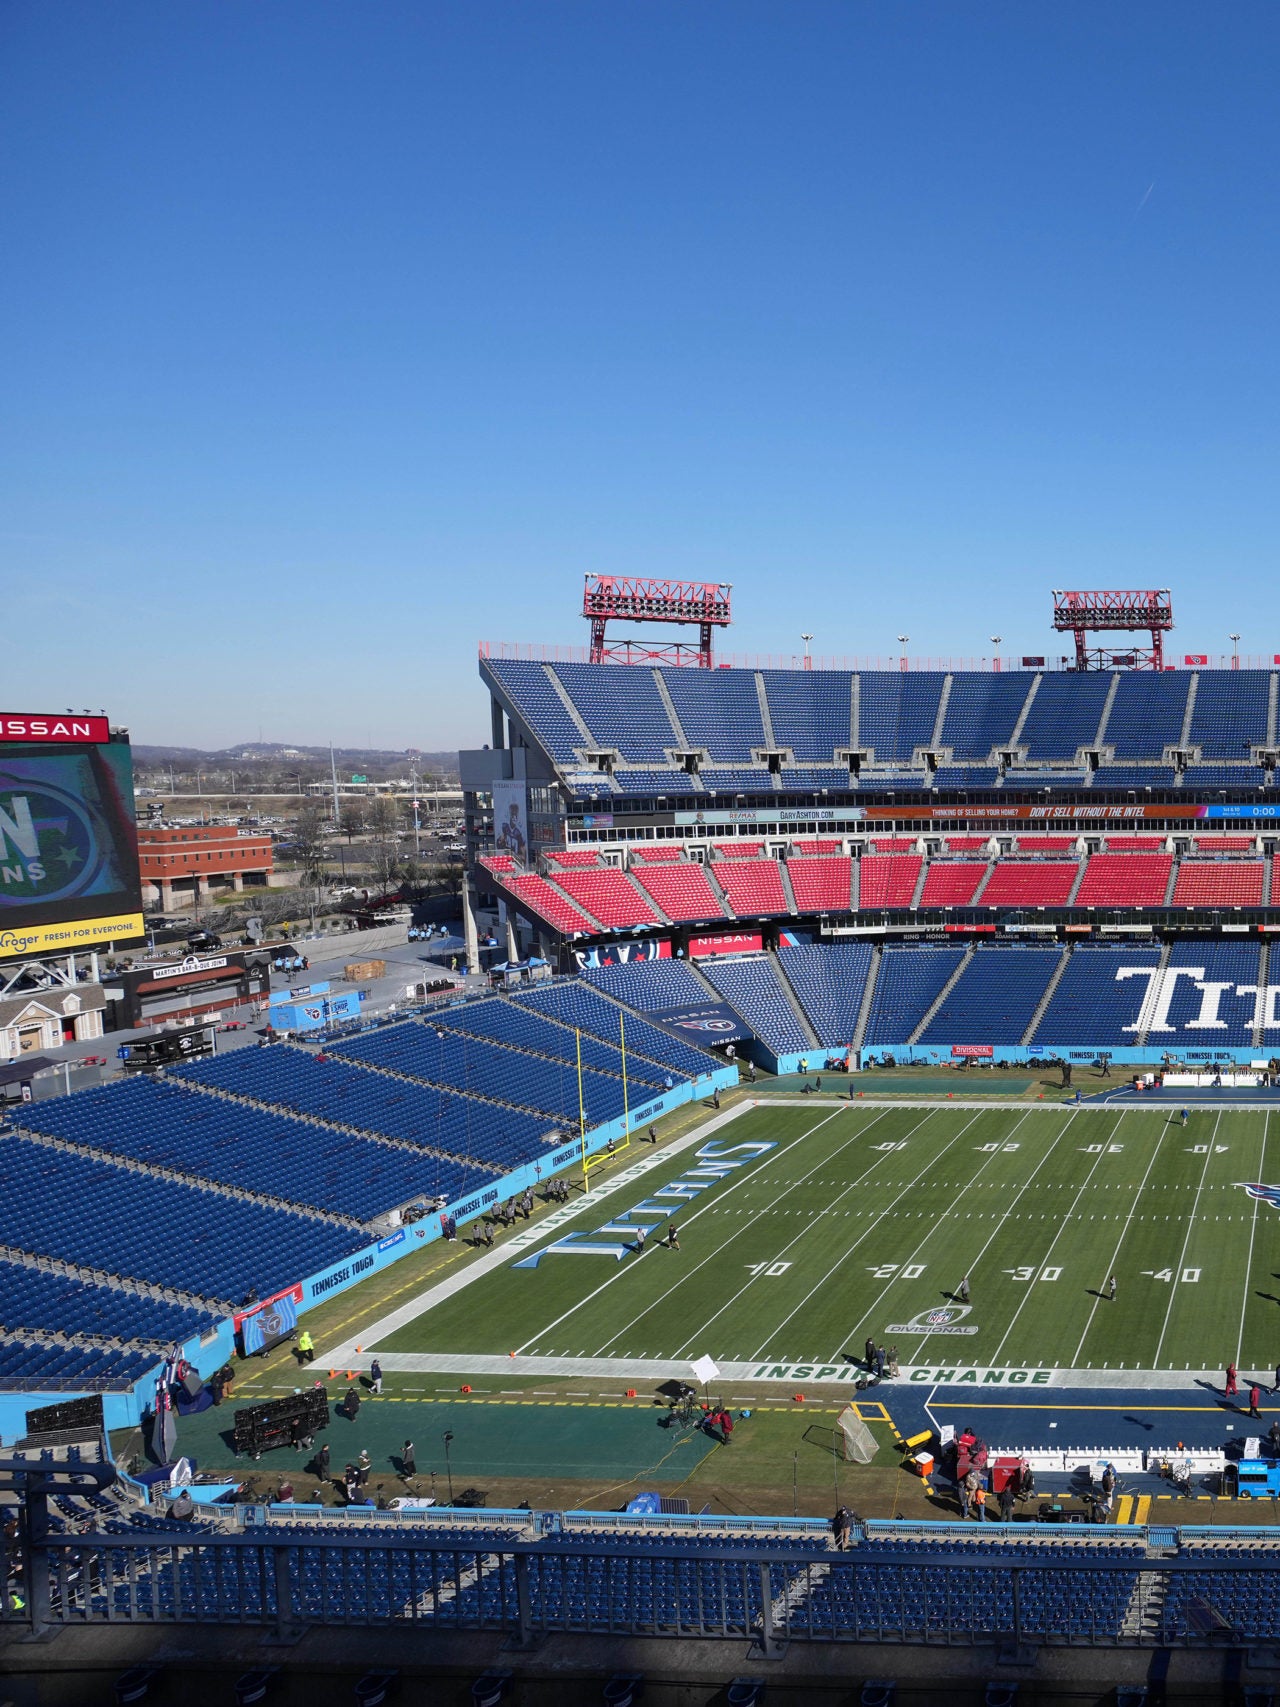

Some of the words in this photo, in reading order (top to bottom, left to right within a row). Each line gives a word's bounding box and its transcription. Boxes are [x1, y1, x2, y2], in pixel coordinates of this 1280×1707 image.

[932, 809, 957, 817] THINKING
[986, 808, 1000, 816] YOUR
[1000, 808, 1019, 816] HOME?
[1029, 807, 1053, 817] DON'T
[1053, 807, 1072, 817] SELL
[1072, 807, 1108, 817] WITHOUT
[1108, 807, 1123, 817] THE
[1123, 807, 1145, 817] INTEL
[1252, 807, 1276, 816] 0:00
[44, 931, 71, 942] FRESH
[73, 928, 90, 937] FOR
[93, 923, 133, 935] EVERYONE
[698, 934, 753, 946] NISSAN
[155, 964, 181, 977] MARTIN'S
[210, 959, 225, 968] JOINT
[662, 1009, 720, 1023] NISSAN
[711, 1035, 741, 1046] NISSAN
[1069, 1051, 1095, 1059] TENNESSEE
[634, 1107, 652, 1123] TENNESSEE
[652, 1100, 664, 1114] TOUGH
[980, 1143, 1021, 1152] 20
[1085, 1144, 1125, 1153] 30
[1192, 1144, 1229, 1154] 40
[552, 1147, 574, 1167] TENNESSEE
[451, 1196, 480, 1221] TENNESSEE
[481, 1187, 499, 1206] TOUGH
[508, 1232, 533, 1246] IT
[533, 1195, 597, 1231] TAKES
[597, 1176, 630, 1195] ALL
[630, 1163, 649, 1175] OF
[647, 1151, 673, 1163] US
[509, 1140, 780, 1269] TITANS
[311, 1266, 350, 1298] TENNESSEE
[352, 1253, 374, 1277] TOUGH
[749, 1262, 793, 1276] 10
[873, 1264, 928, 1279] 20
[1011, 1266, 1064, 1281] 30
[1152, 1268, 1202, 1283] 40
[929, 1314, 947, 1323] NFL
[889, 1325, 972, 1334] DIVISIONAL
[753, 1365, 891, 1380] INSPIR
[910, 1369, 1052, 1384] CHANGE
